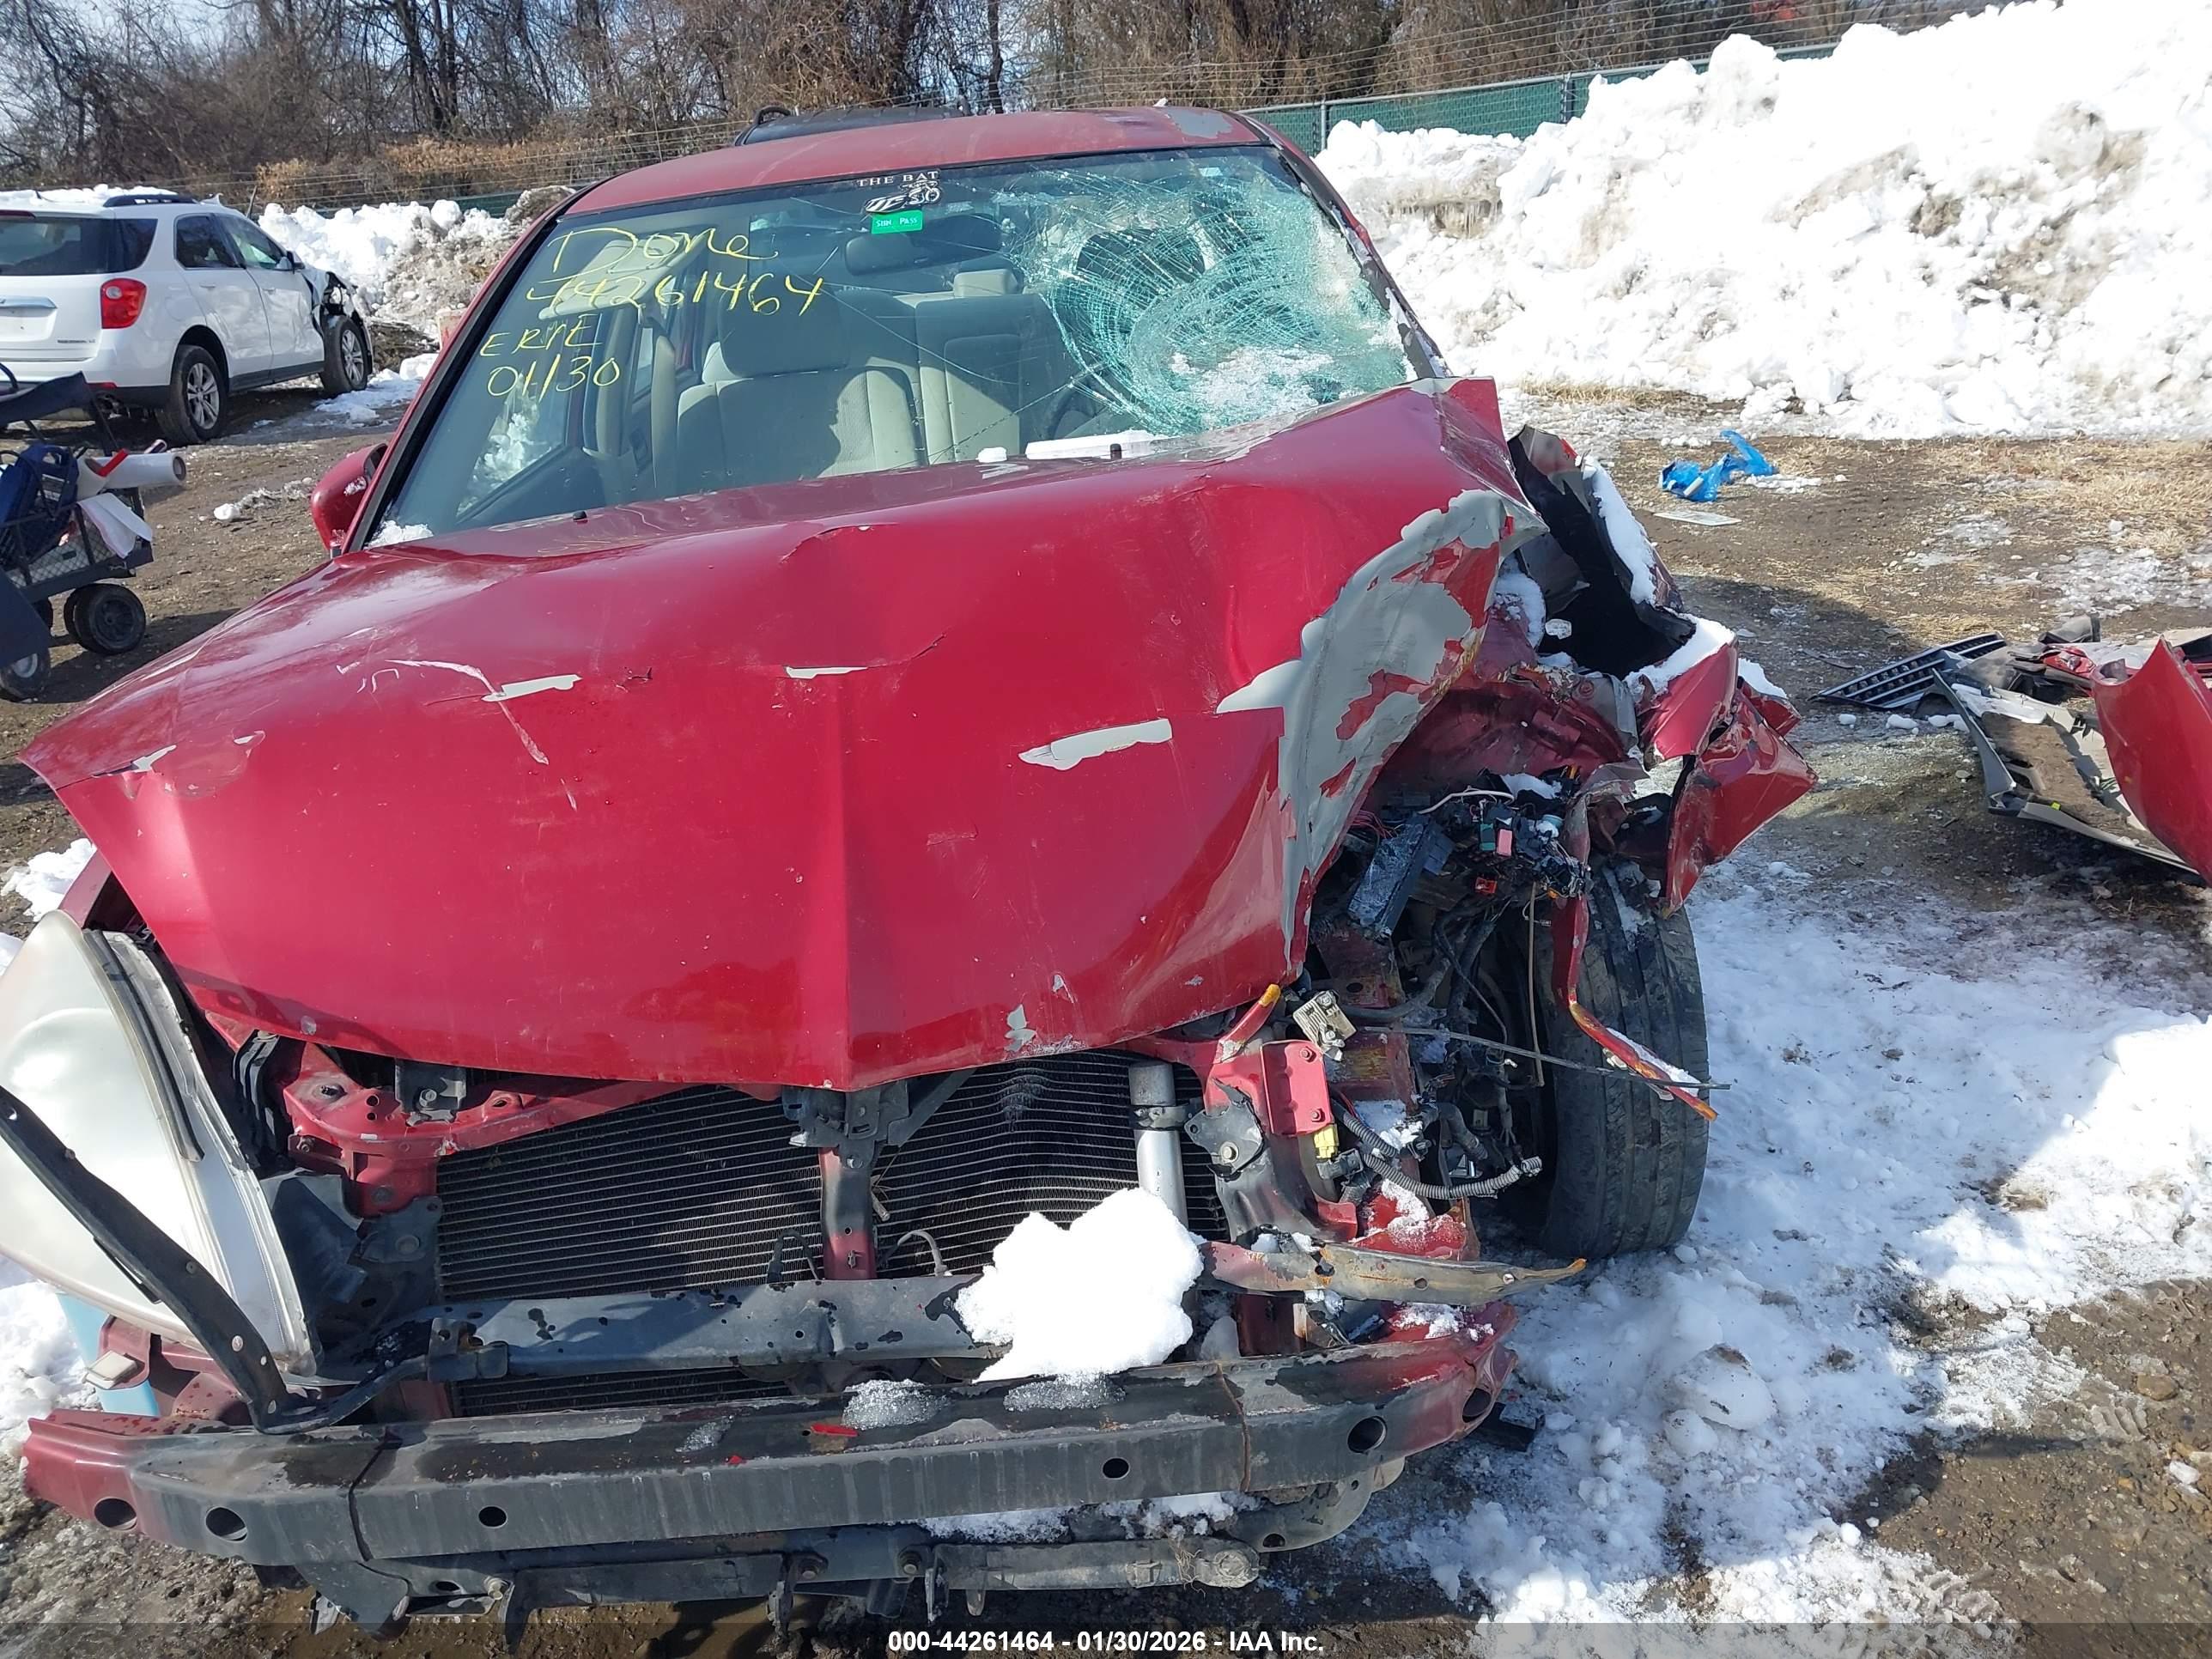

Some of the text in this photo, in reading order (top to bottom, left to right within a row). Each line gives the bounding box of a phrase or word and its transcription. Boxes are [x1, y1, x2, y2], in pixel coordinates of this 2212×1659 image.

[857, 171, 939, 186] THE BAT
[899, 216, 918, 225] PASS
[538, 228, 779, 283] Done
[526, 270, 822, 317] 44261464
[487, 354, 621, 403] 01/30
